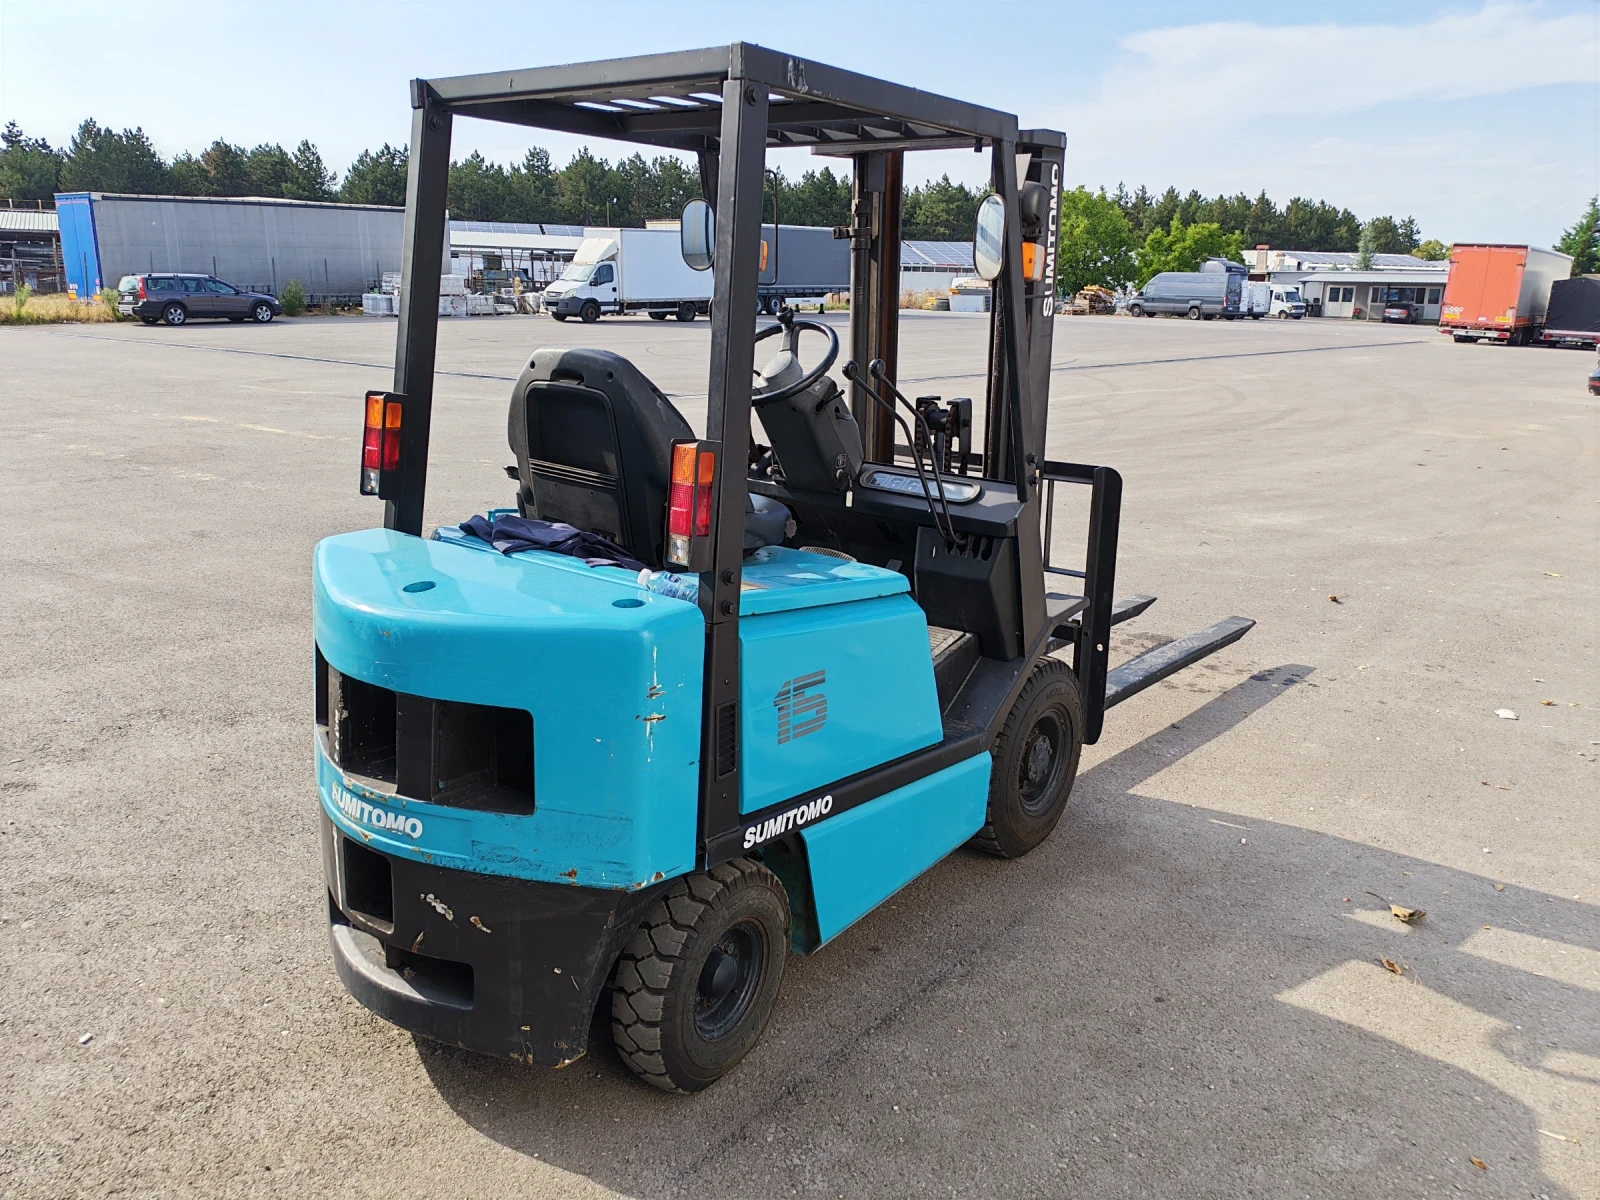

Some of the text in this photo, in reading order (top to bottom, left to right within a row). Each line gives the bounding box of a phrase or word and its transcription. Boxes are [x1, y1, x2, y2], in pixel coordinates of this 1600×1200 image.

[1043, 163, 1059, 317] SUMITOMO
[774, 669, 827, 745] 15
[332, 781, 423, 838] SUMITOMO
[743, 795, 833, 848] SUMITOMO
